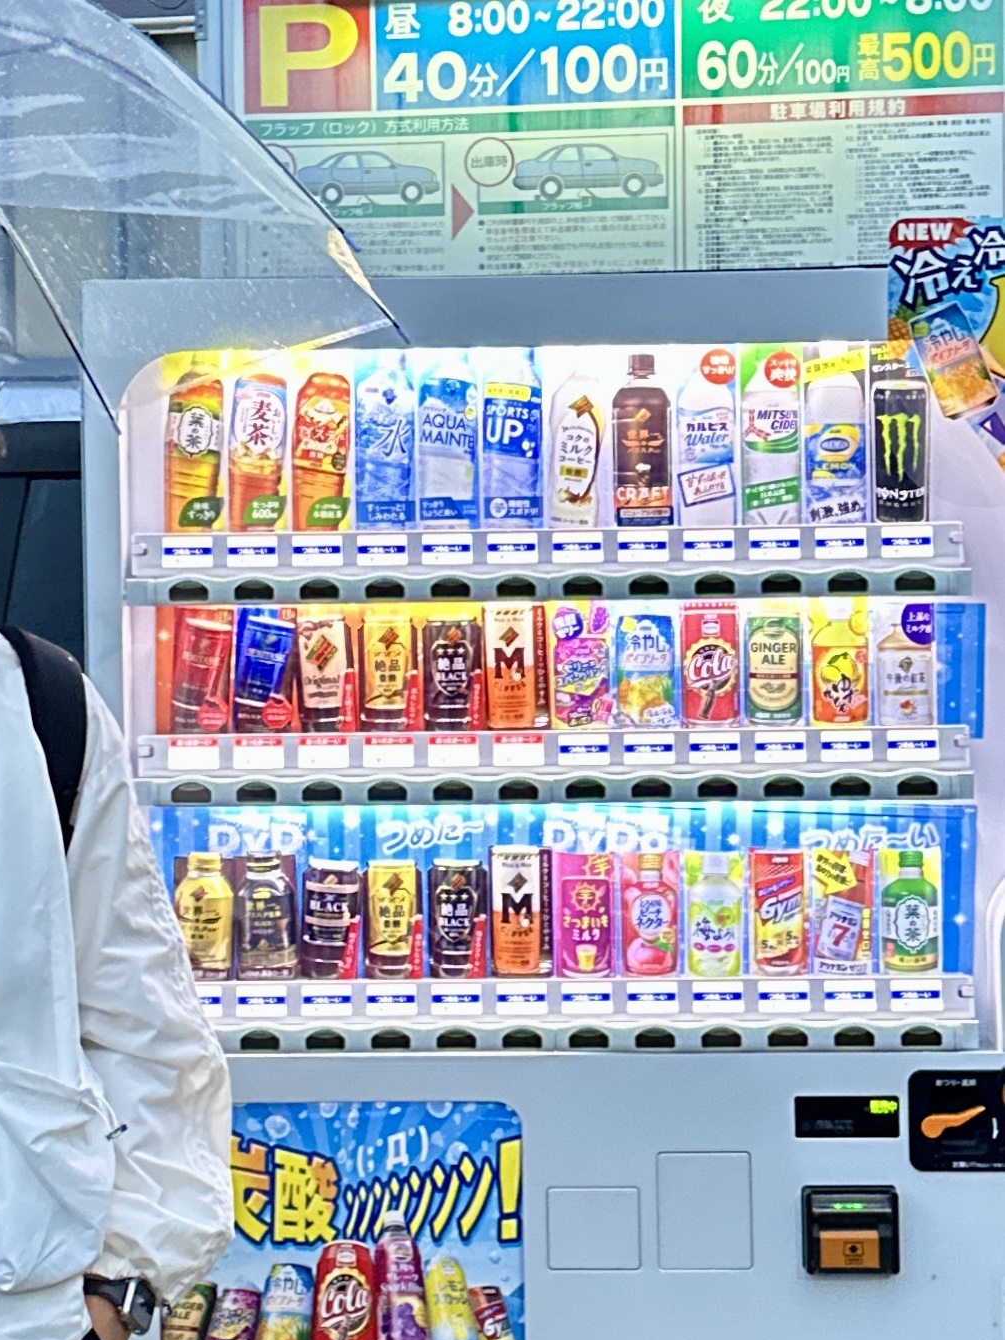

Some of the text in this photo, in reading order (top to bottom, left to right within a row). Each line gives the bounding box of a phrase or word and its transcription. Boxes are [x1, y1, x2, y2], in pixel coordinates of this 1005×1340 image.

[385, 3, 421, 40] 昼
[259, 4, 359, 107] P
[770, 98, 906, 120] 駐車場利用規約
[897, 222, 953, 241] NEW
[486, 405, 529, 420] SPORTS
[185, 412, 206, 449] 葉の茶
[246, 400, 272, 446] 麦茶
[422, 413, 466, 431] AQUA
[686, 422, 729, 432] カルピス
[372, 419, 410, 457] 水
[420, 430, 474, 449] MAINTE
[486, 418, 524, 445] UP
[566, 434, 590, 444] コクの
[684, 431, 729, 446] Water
[560, 441, 593, 456] ミルク
[559, 455, 592, 465] コーヒー
[617, 486, 669, 501] CRAFT
[630, 634, 667, 653] 冷やし
[750, 641, 797, 653] GINGER
[494, 647, 526, 679] M
[688, 648, 735, 681] Cola
[761, 654, 786, 665] ALE
[436, 671, 468, 681] BLACK
[886, 671, 926, 684] 午後の紅茶
[208, 823, 303, 852] DyD
[309, 900, 349, 913] BLACK
[501, 893, 534, 924] M
[640, 908, 663, 919] ピーチ
[439, 917, 470, 927] BLACK
[562, 914, 609, 929] さつまいも
[635, 917, 669, 930] ネクター
[904, 903, 922, 942] 葉の茶
[571, 930, 601, 942] ミルク
[832, 923, 851, 947] 7
[320, 1280, 370, 1318] Cola
